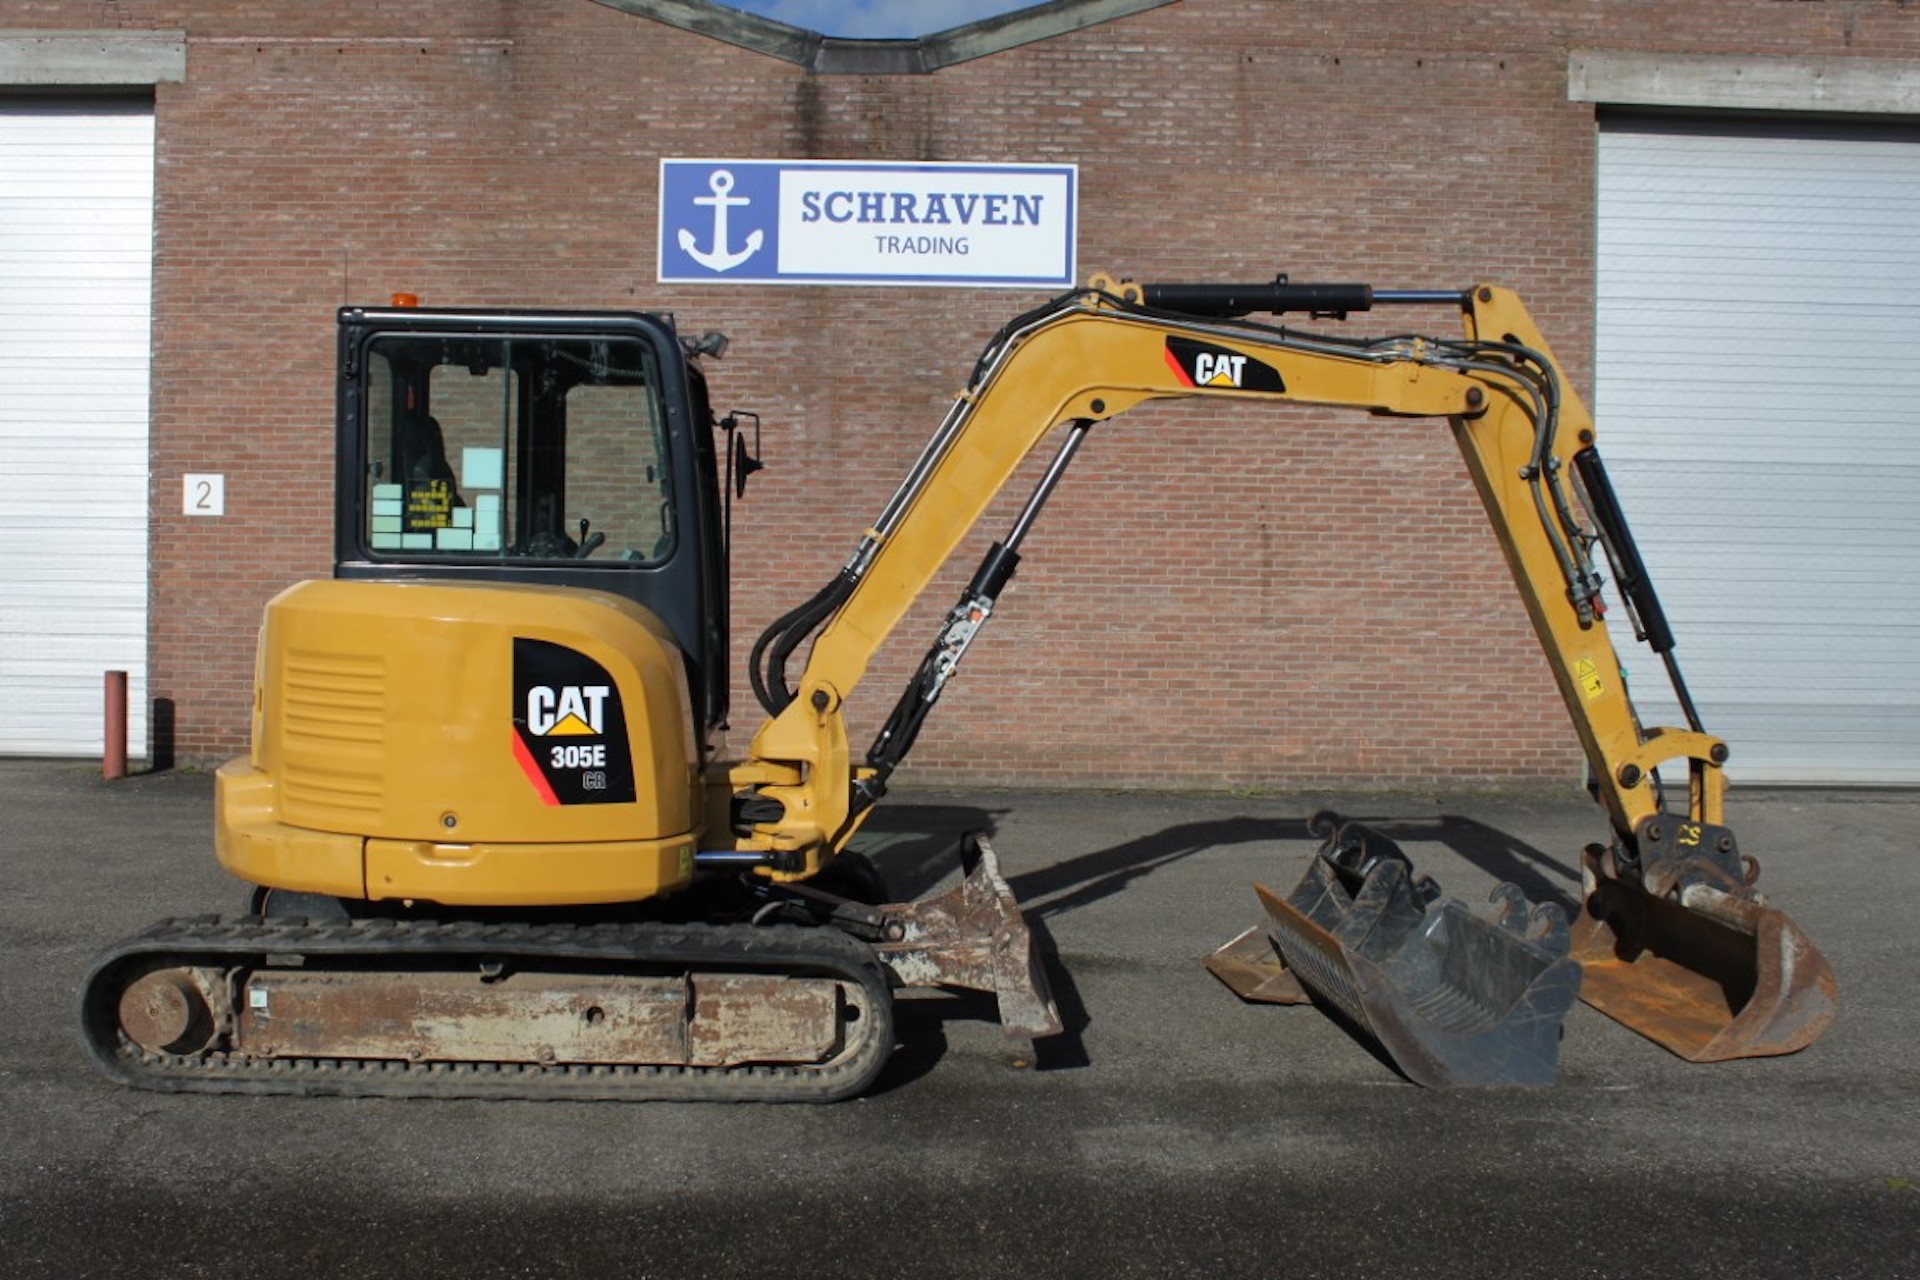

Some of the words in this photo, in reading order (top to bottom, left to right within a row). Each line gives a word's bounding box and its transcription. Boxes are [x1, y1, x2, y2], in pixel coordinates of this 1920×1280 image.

[801, 191, 1044, 226] SCHRAVEN
[875, 235, 970, 256] TRADING
[1195, 352, 1248, 388] CAT
[196, 481, 211, 509] 2
[527, 685, 610, 736] CAT
[550, 745, 606, 769] 305E
[583, 770, 606, 790] CR
